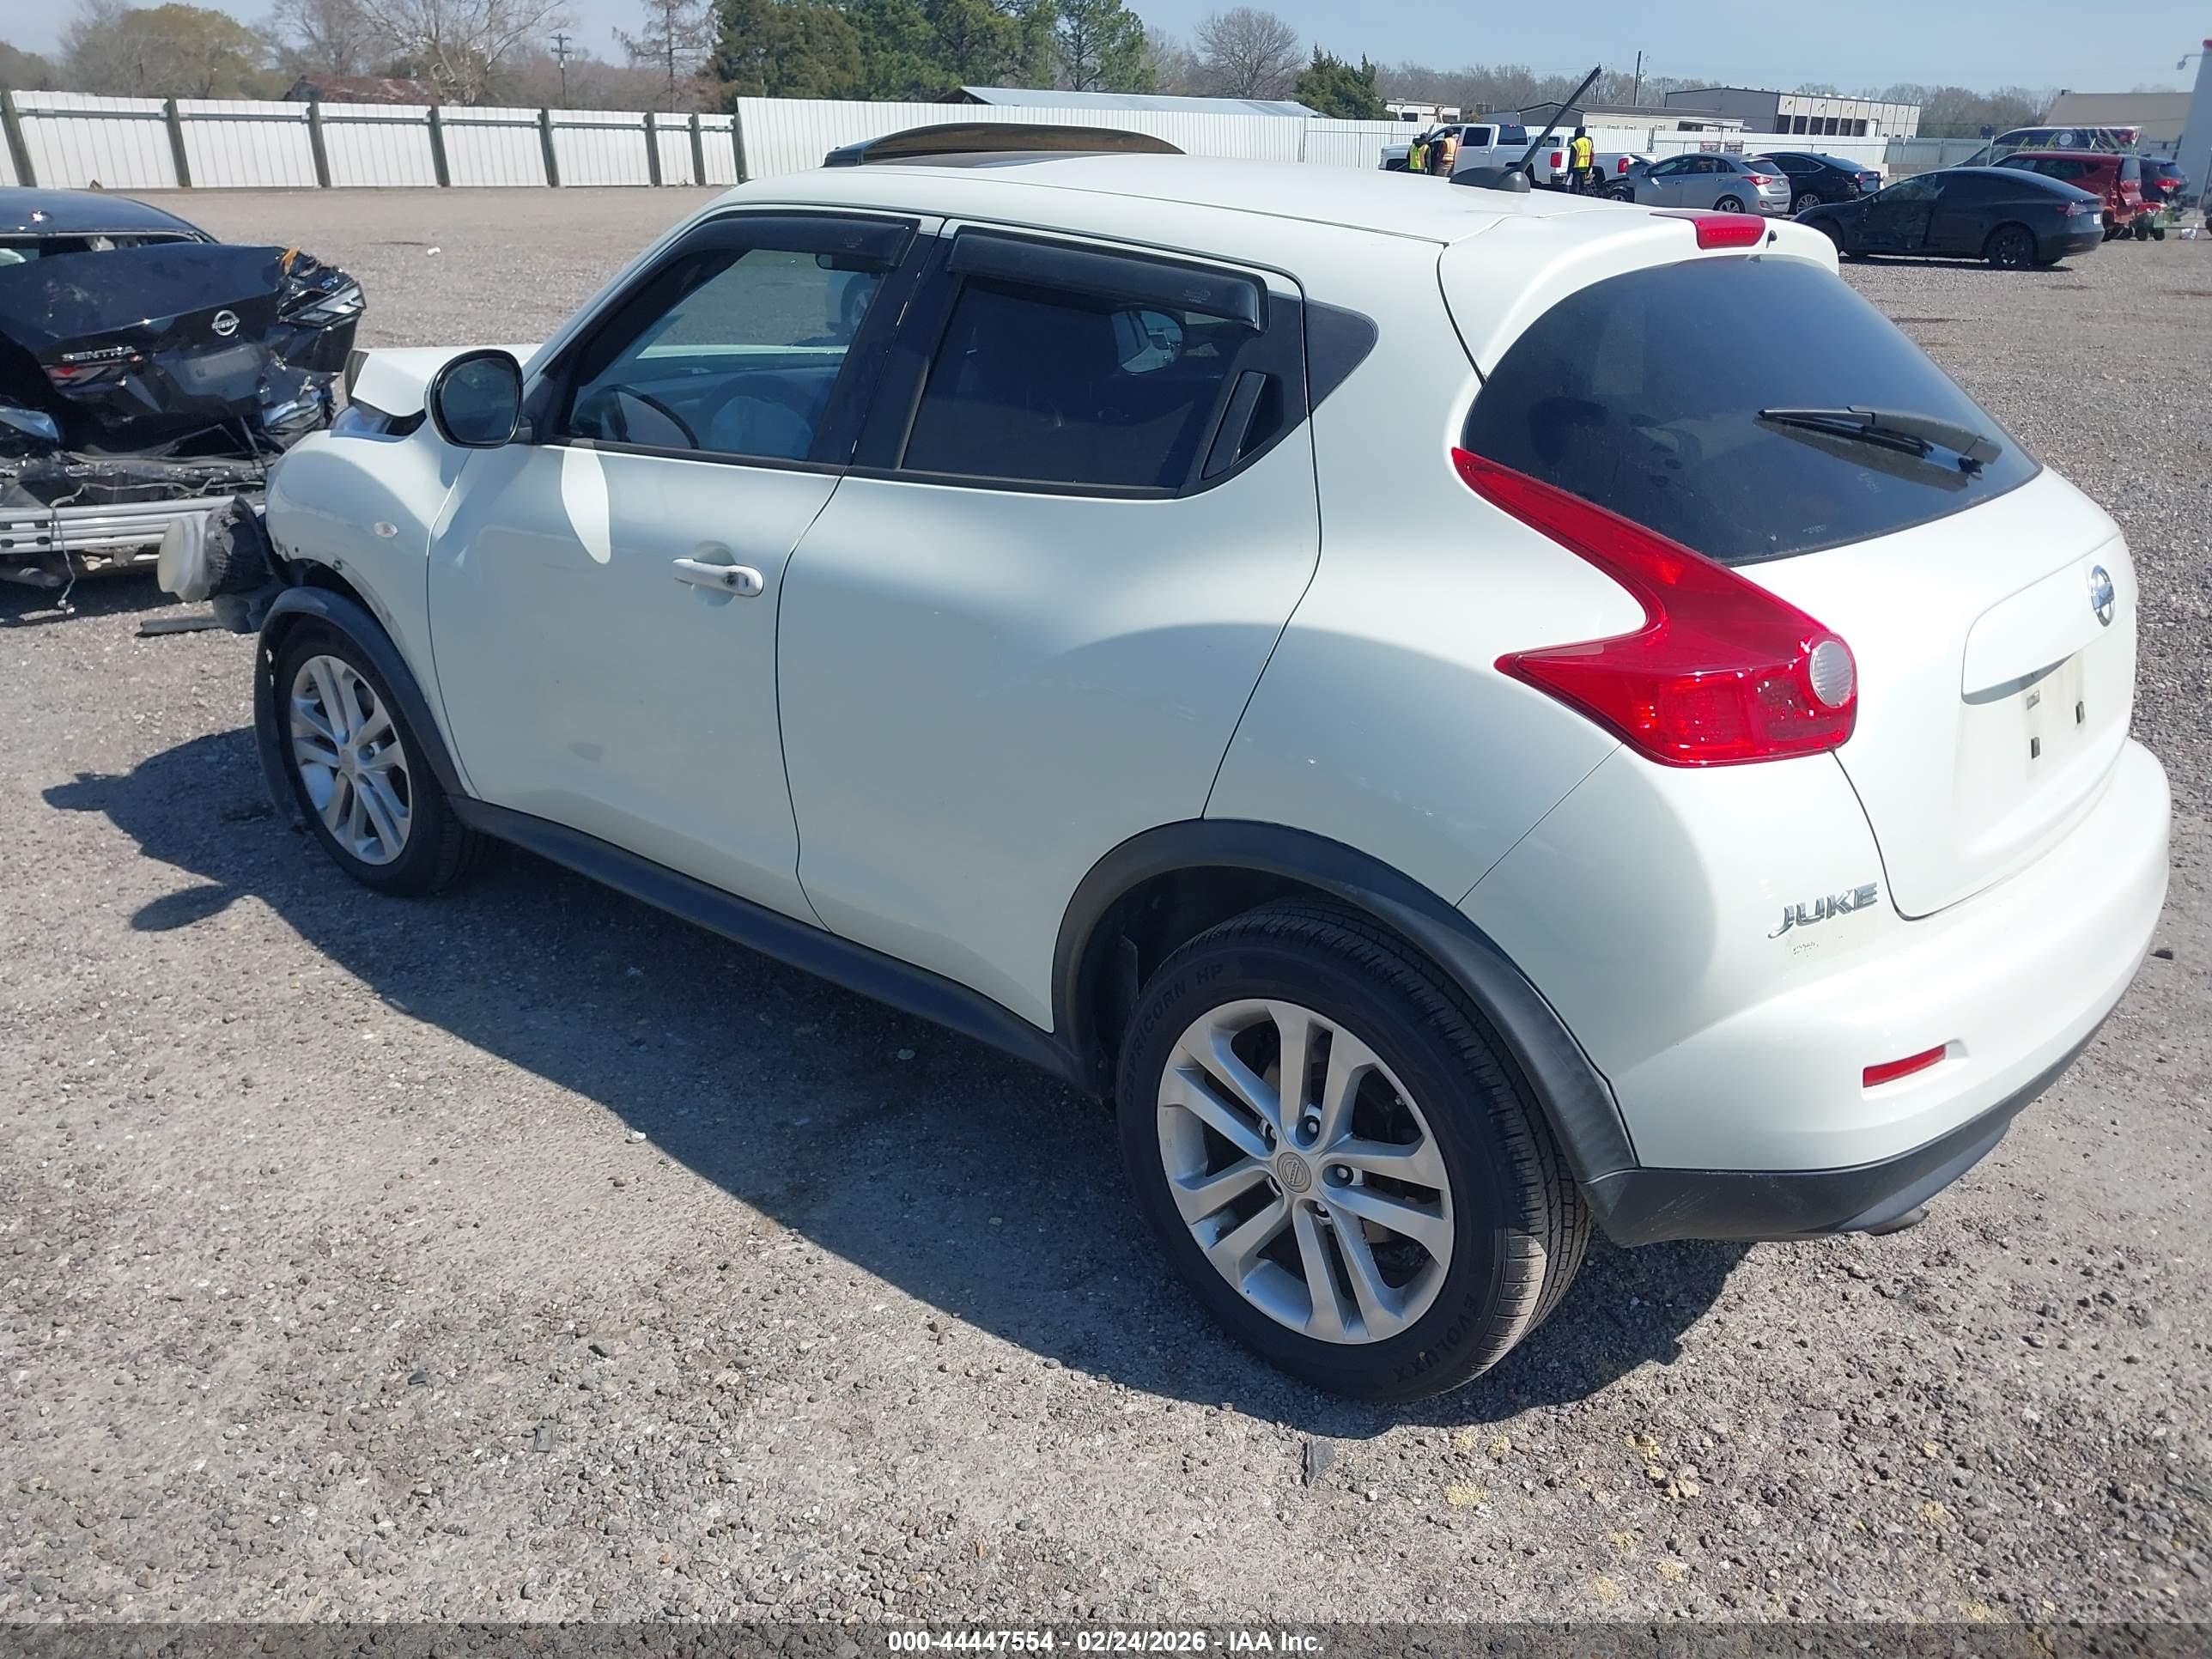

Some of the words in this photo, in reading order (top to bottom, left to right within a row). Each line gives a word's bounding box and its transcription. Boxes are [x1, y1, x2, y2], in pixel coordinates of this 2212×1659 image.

[62, 346, 137, 362] SENTRA
[1767, 882, 1878, 939] JUKE
[1124, 981, 1187, 1105] CAPRICORN
[1196, 963, 1224, 983] HP
